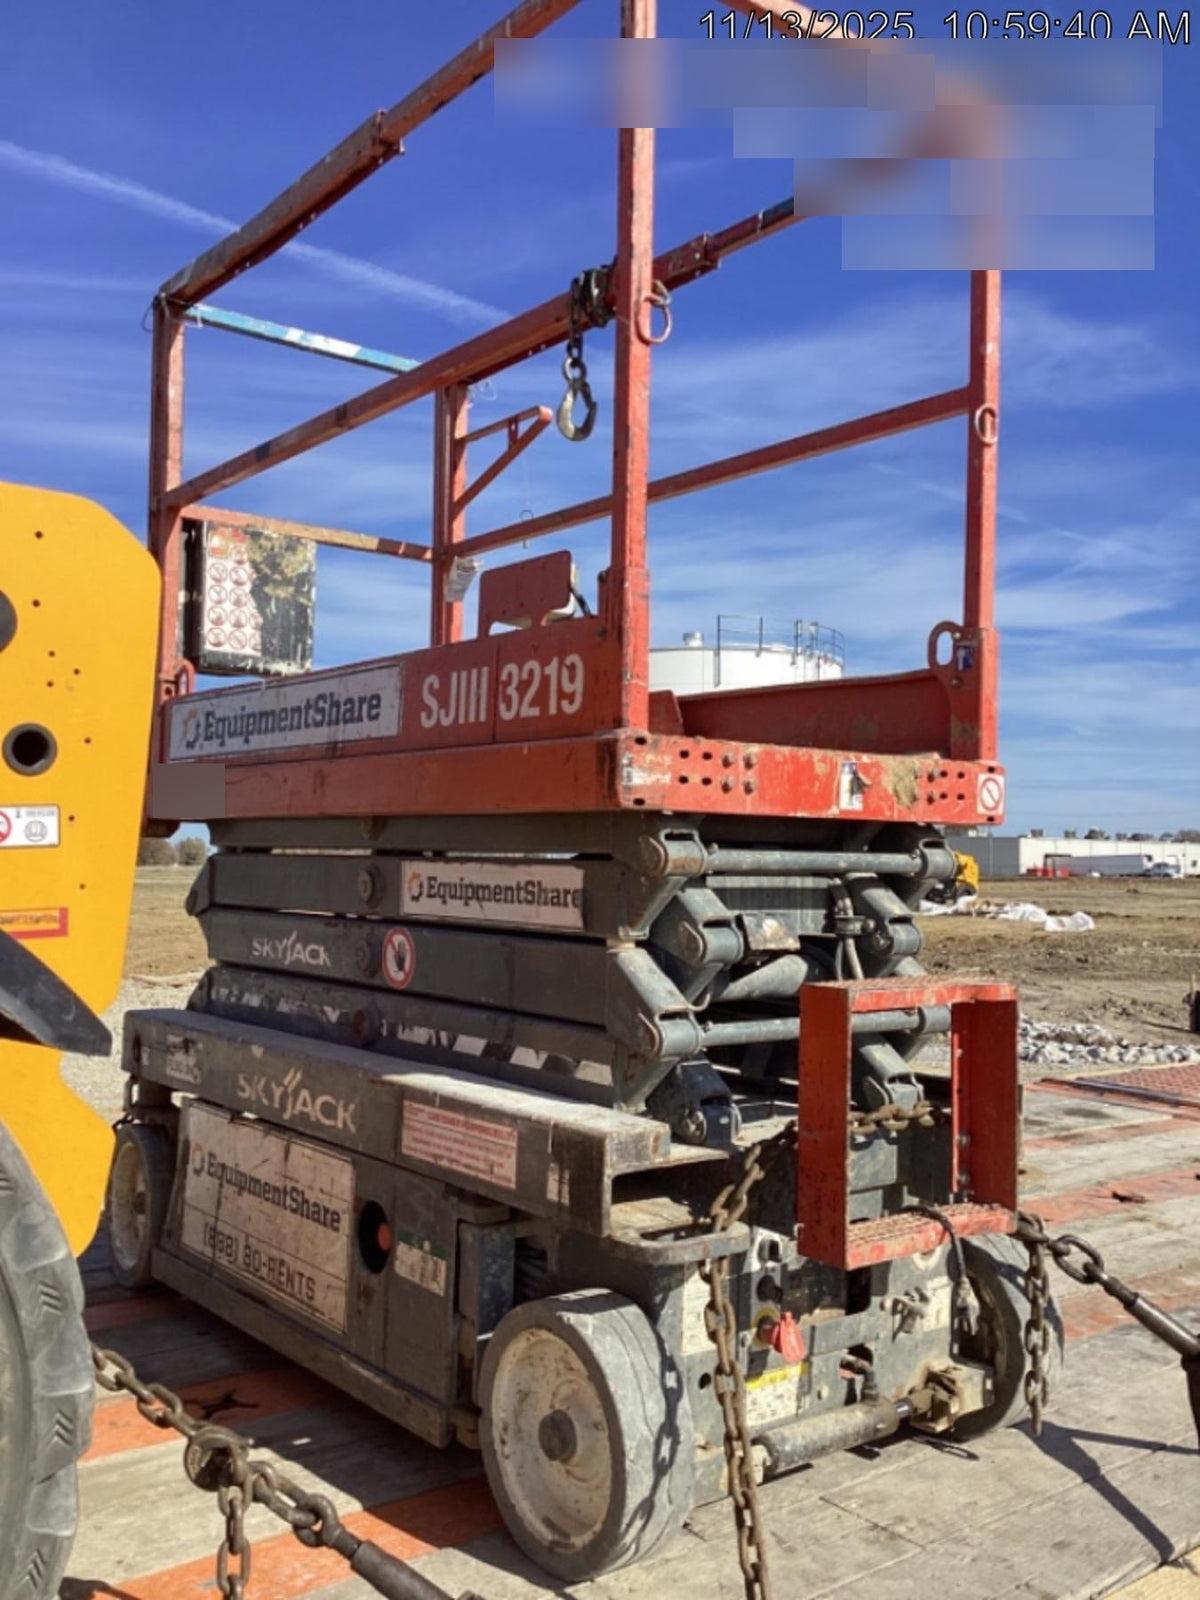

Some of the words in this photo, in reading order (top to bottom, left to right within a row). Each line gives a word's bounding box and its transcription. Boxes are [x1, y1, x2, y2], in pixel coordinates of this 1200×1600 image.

[499, 653, 584, 721] 3219
[203, 692, 381, 747] EquipmentShare
[251, 929, 332, 968] SKYJACK
[236, 1066, 356, 1134] SKYJACK
[207, 1152, 341, 1233] EquipmentShare
[243, 1244, 316, 1301] 80-RENTS
